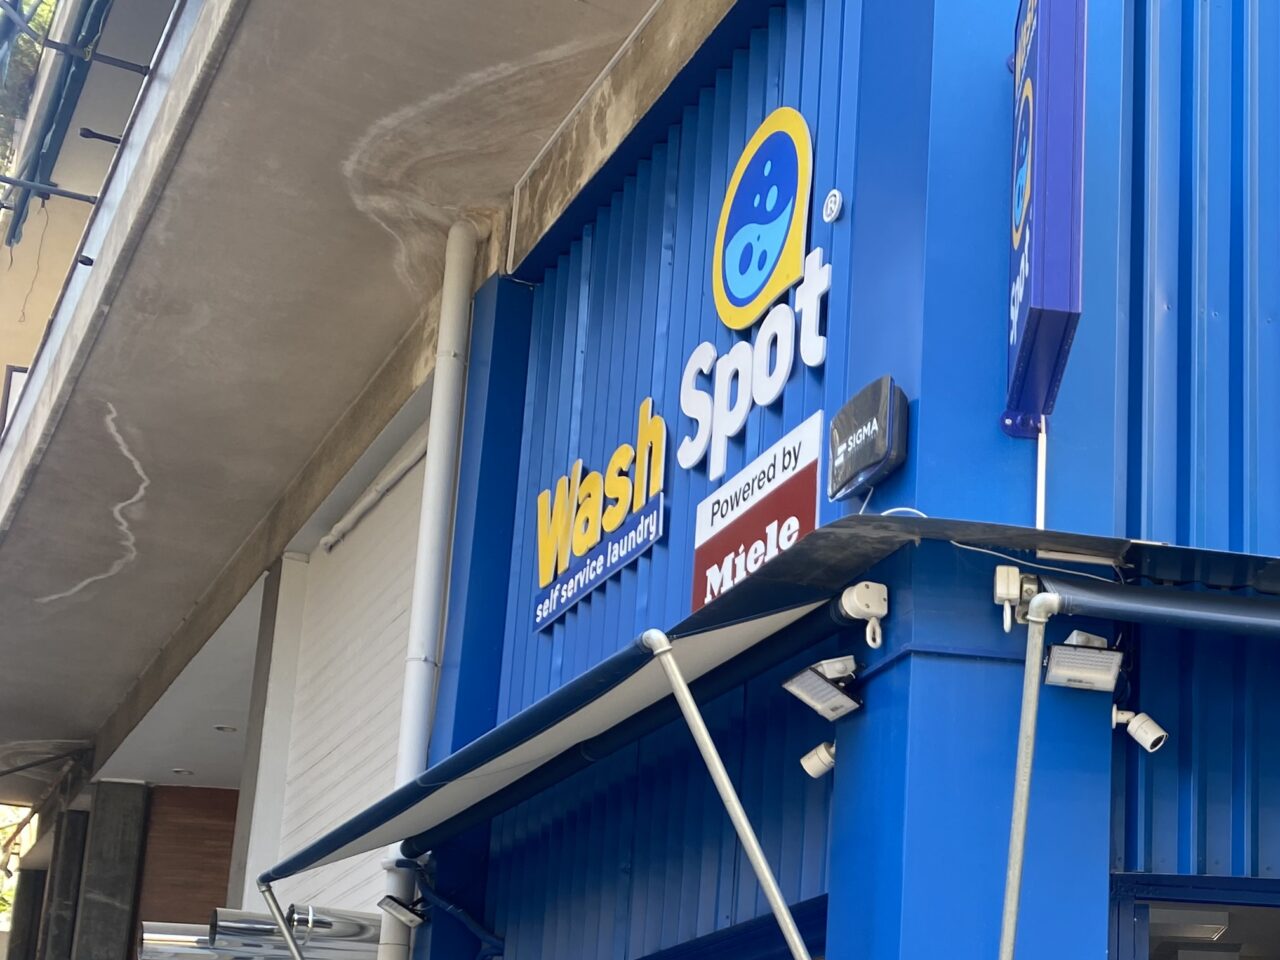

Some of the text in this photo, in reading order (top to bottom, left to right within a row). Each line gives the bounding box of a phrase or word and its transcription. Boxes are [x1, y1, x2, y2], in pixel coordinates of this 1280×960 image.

[677, 246, 832, 482] Spot
[711, 440, 802, 527] Powered by
[847, 417, 879, 452] SIGMA
[537, 396, 667, 589] Wash
[535, 508, 658, 623] self service laundry
[704, 513, 801, 604] Miele
